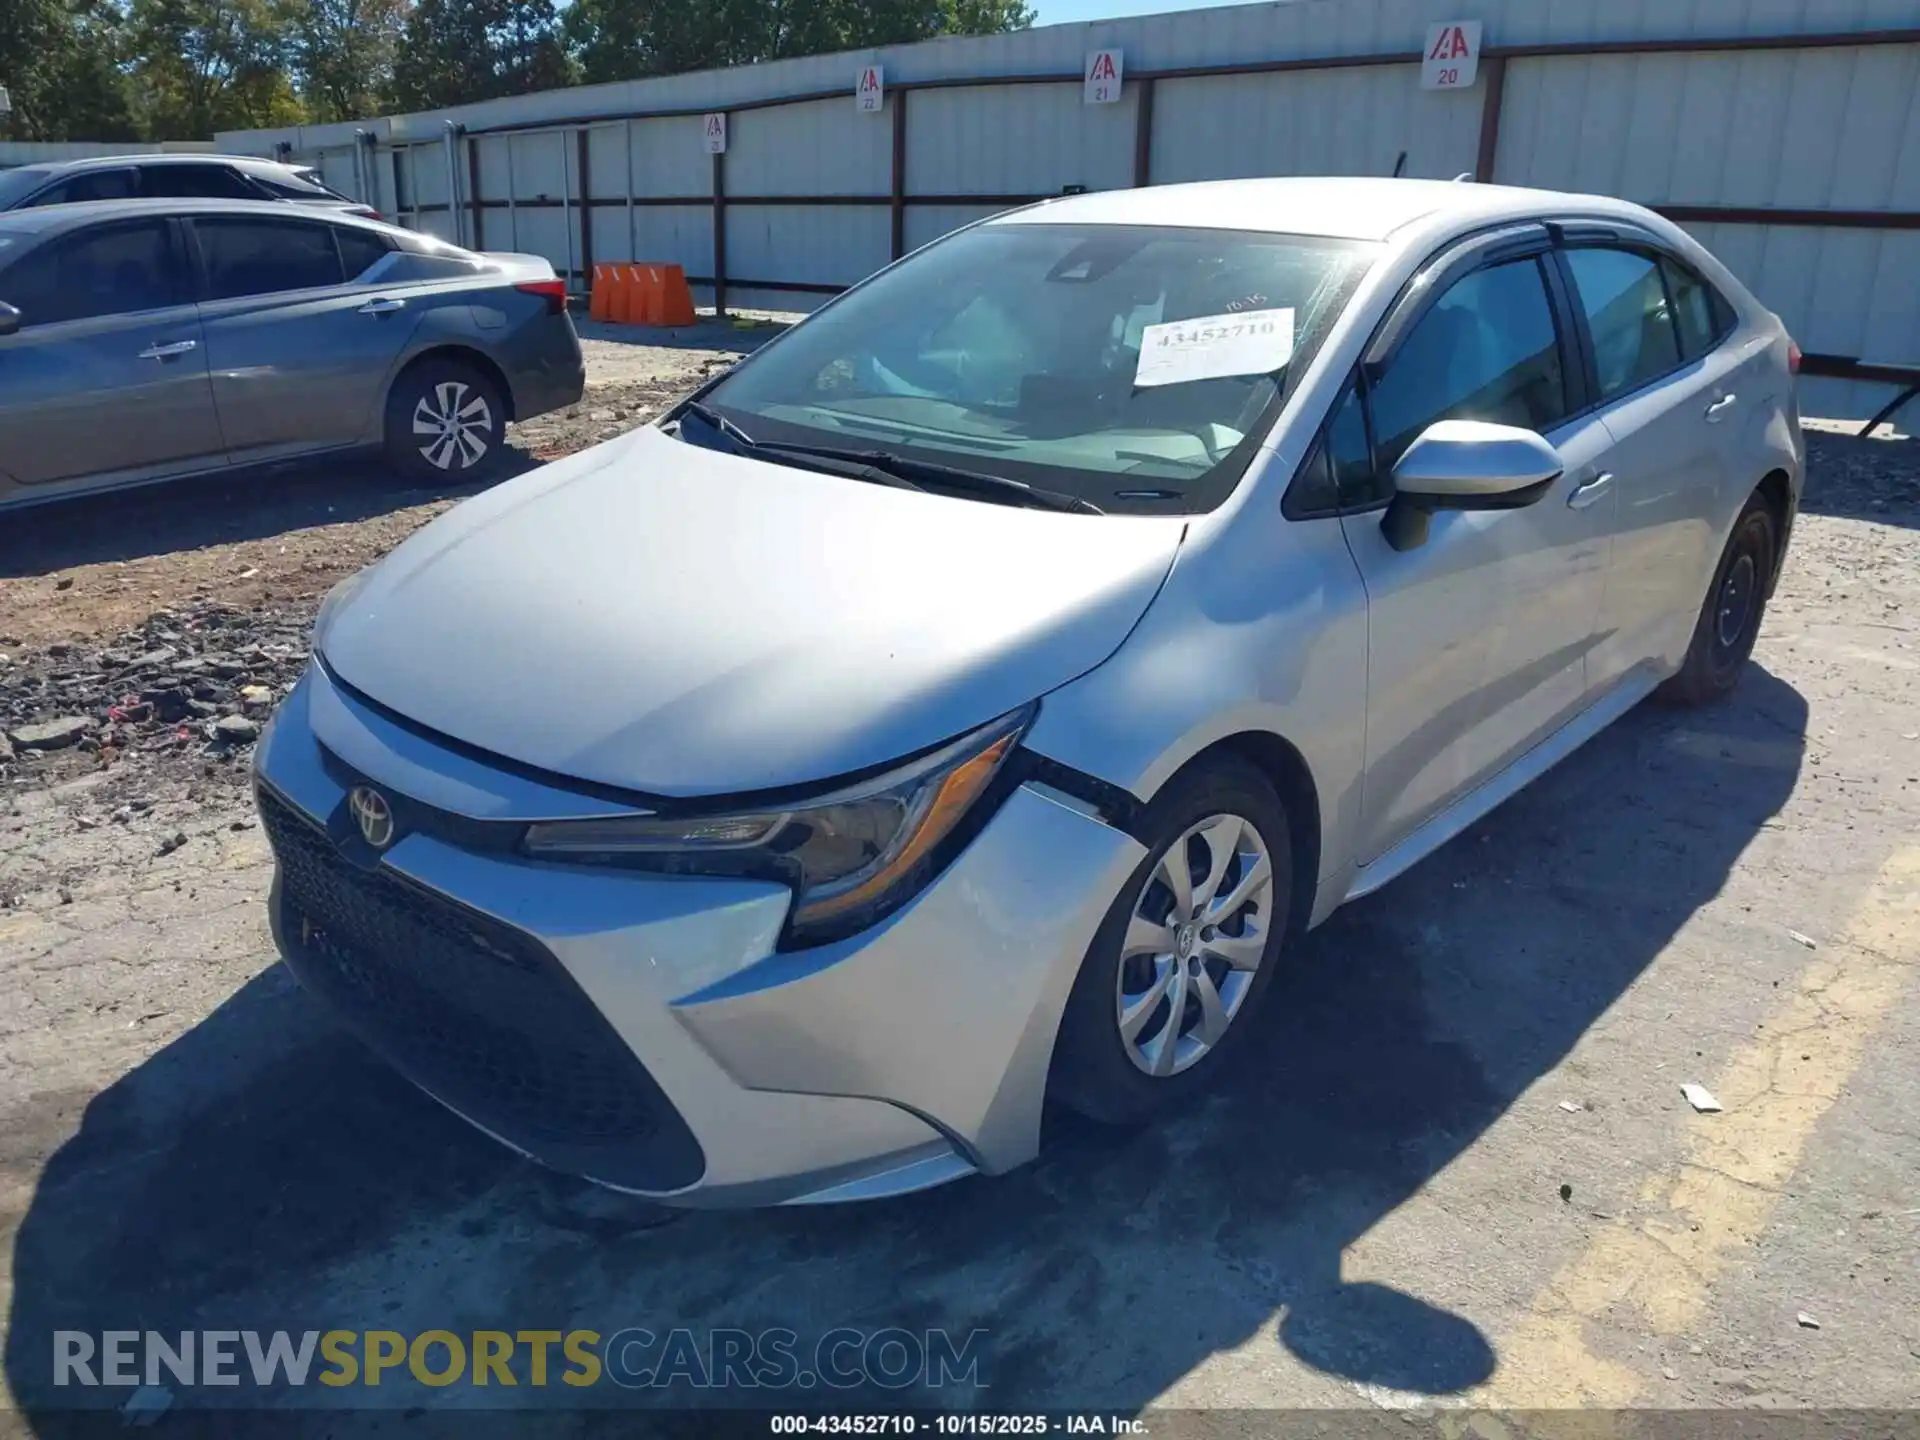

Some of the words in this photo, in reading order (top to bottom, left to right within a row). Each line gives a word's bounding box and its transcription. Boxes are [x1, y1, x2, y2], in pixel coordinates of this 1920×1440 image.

[1438, 69, 1458, 85] 20
[1095, 87, 1108, 101] 21
[1157, 321, 1275, 347] 43452710
